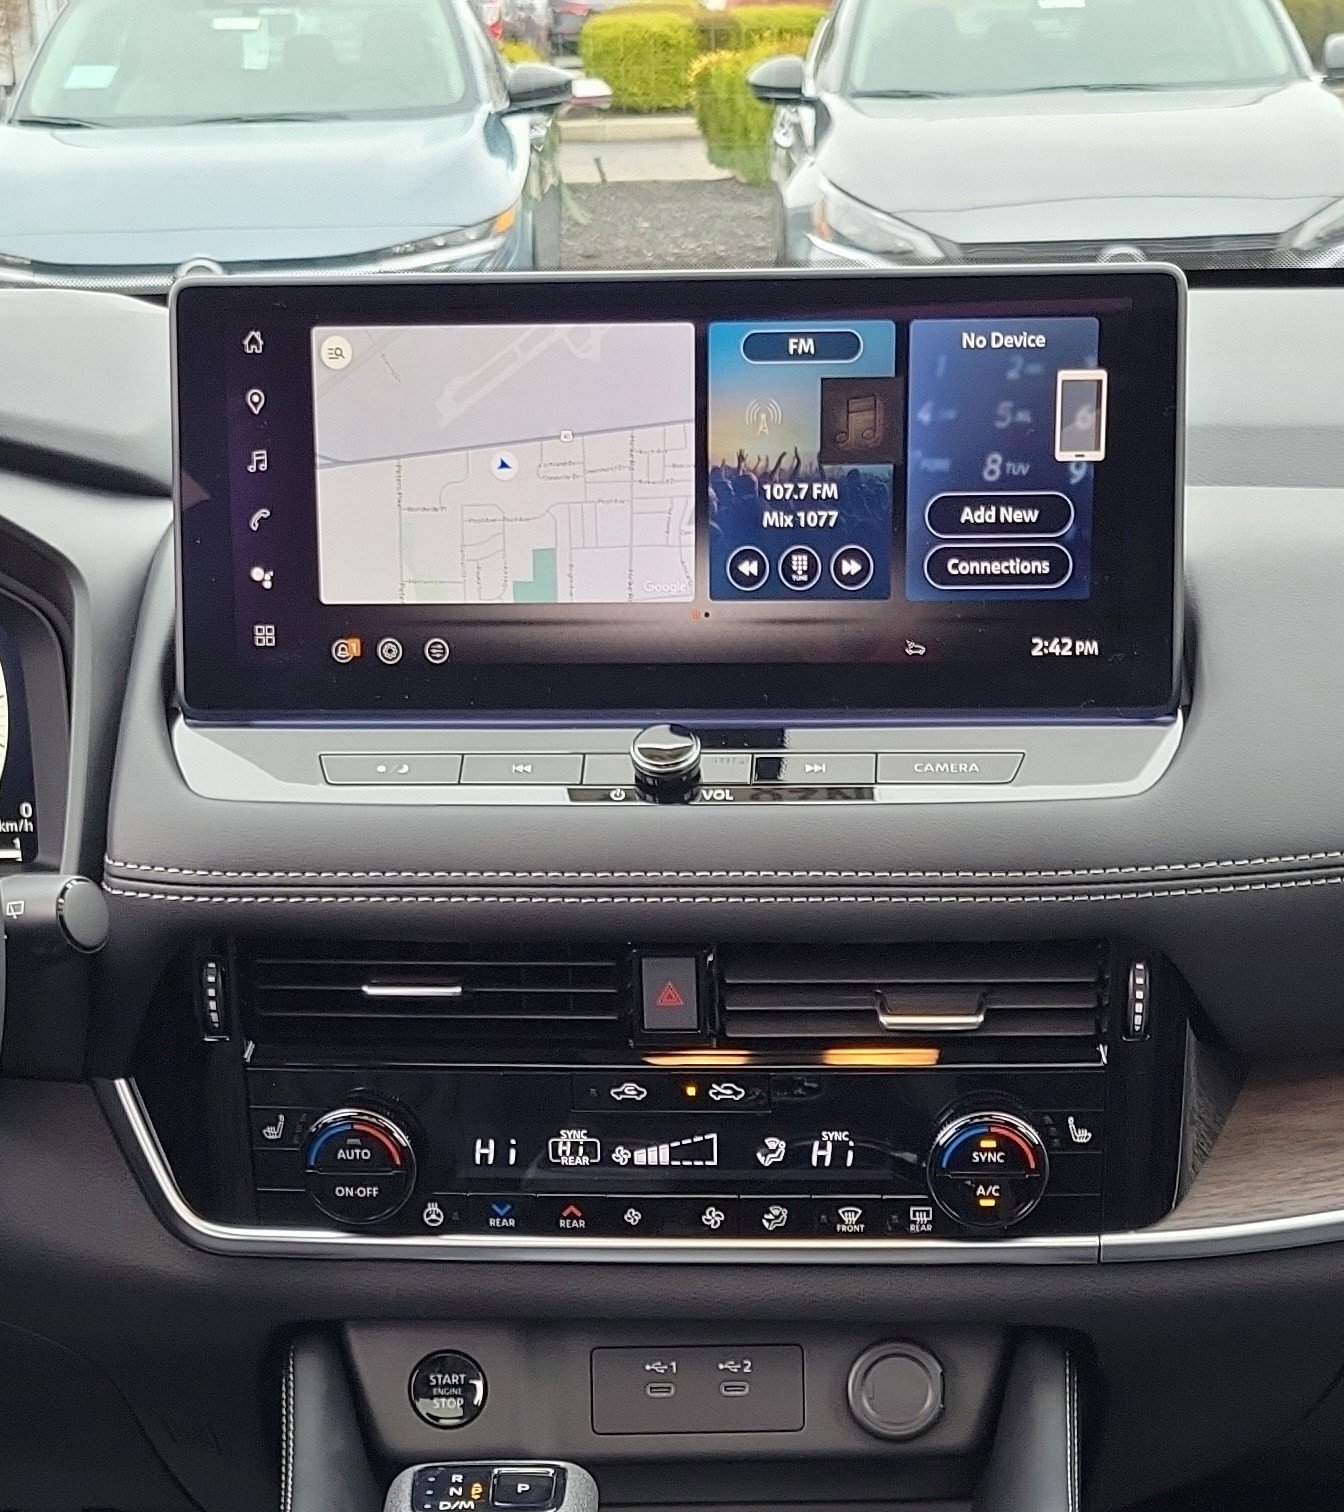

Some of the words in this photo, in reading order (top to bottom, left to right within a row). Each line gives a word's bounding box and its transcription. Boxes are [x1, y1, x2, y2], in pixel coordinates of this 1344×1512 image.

[962, 332, 986, 348] No
[991, 332, 1046, 348] Device
[788, 338, 815, 355] FM
[762, 483, 808, 501] 107.7
[812, 482, 838, 500] FM
[762, 511, 793, 528] Mix
[797, 511, 839, 528] 1077
[960, 506, 995, 524] Add
[998, 506, 1039, 523] New
[947, 557, 1050, 576] Connections
[644, 580, 687, 597] Google
[1031, 636, 1071, 656] 2:42
[1075, 640, 1099, 656] PM
[914, 761, 980, 775] CAMERA
[702, 789, 733, 801] VOL
[19, 802, 33, 818] 0
[560, 1130, 587, 1139] SYNC
[821, 1131, 850, 1142] SYNC
[337, 1149, 371, 1160] AUTO
[560, 1155, 590, 1165] REAR
[972, 1152, 1005, 1164] SYNC
[976, 1185, 1000, 1197] A/C
[489, 1217, 515, 1227] REAR
[559, 1219, 585, 1228] REAR
[910, 1223, 932, 1232] REAR
[836, 1224, 865, 1233] FRONT
[670, 1361, 677, 1372] 1
[743, 1361, 752, 1373] 2
[429, 1374, 466, 1386] START
[433, 1387, 462, 1396] ENGINE
[433, 1397, 464, 1409] STOP
[451, 1474, 463, 1484] R
[449, 1487, 463, 1497] N
[517, 1484, 530, 1493] P
[439, 1501, 475, 1510] D/M
